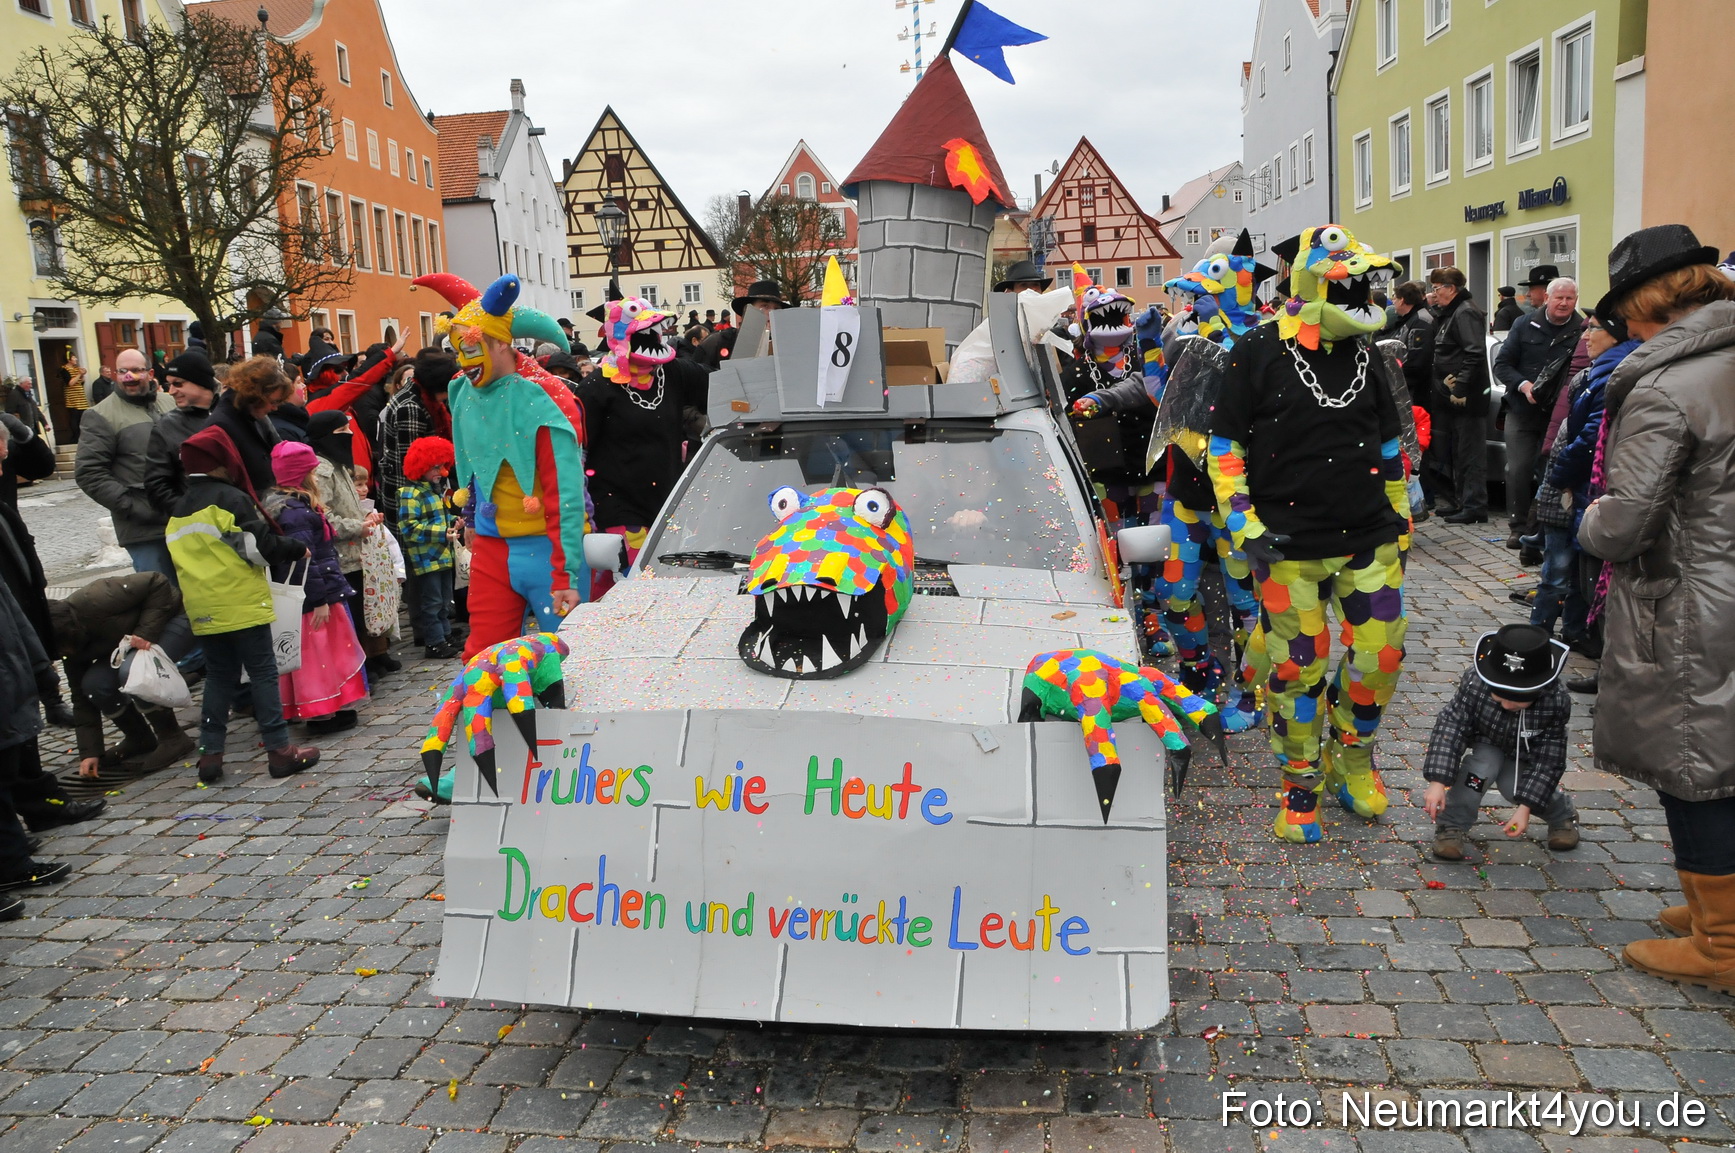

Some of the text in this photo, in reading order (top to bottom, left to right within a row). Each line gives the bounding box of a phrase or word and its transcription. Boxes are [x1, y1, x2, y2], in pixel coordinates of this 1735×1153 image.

[1464, 200, 1505, 223] Neumeyer
[1518, 188, 1552, 210] Allianz
[1553, 253, 1570, 263] Allianz
[831, 331, 853, 368] 8
[521, 739, 953, 825] Frühers wie Heute
[498, 847, 1091, 955] Drachen und verrückte Leute
